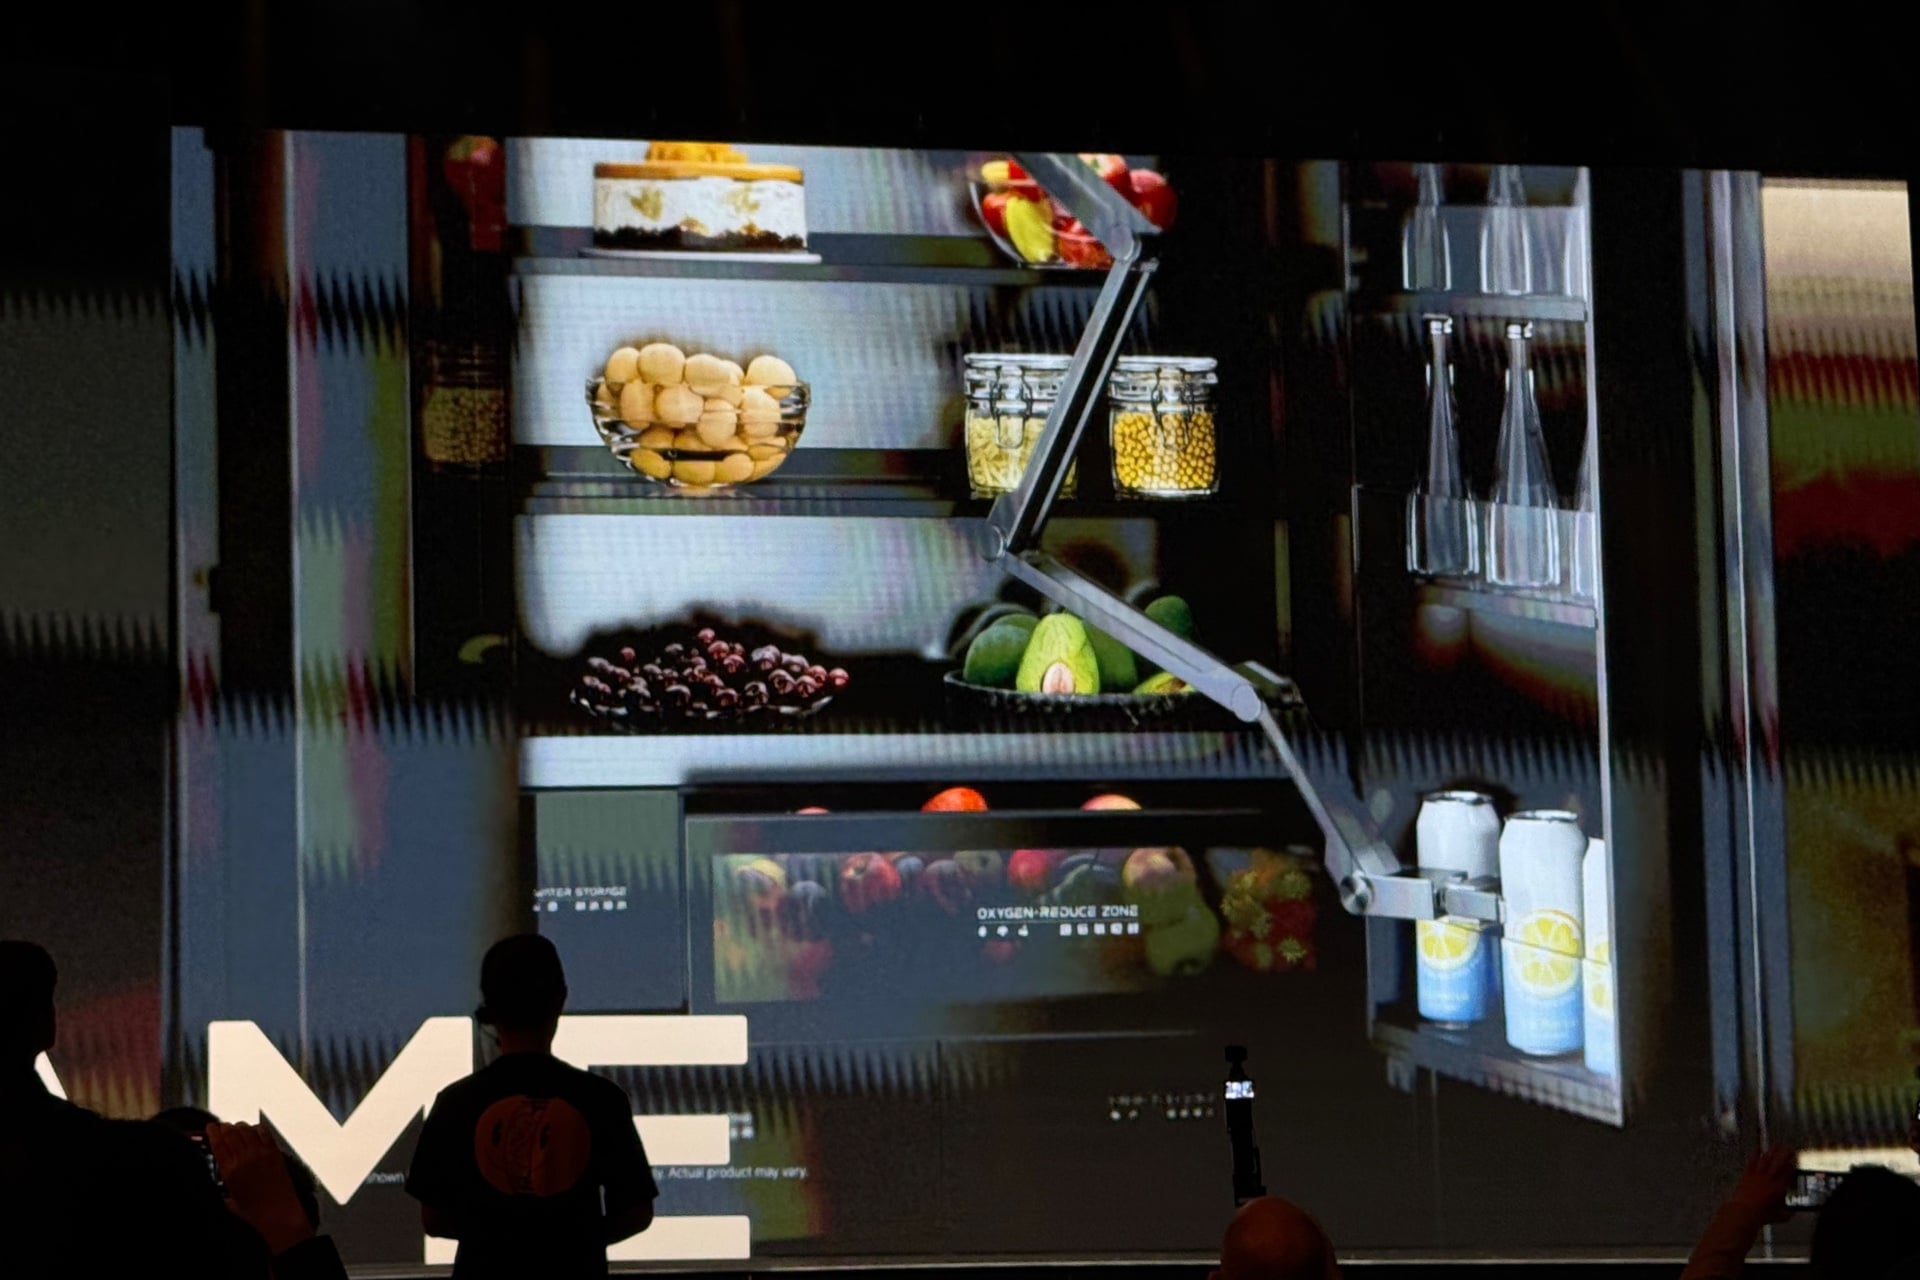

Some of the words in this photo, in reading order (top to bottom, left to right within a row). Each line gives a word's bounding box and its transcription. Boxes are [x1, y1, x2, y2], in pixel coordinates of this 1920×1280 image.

[1101, 904, 1139, 917] ZONE
[34, 1015, 751, 1263] ME
[667, 1167, 704, 1179] Actual
[706, 1167, 753, 1181] product
[755, 1167, 779, 1180] may
[782, 1167, 808, 1180] vary.
